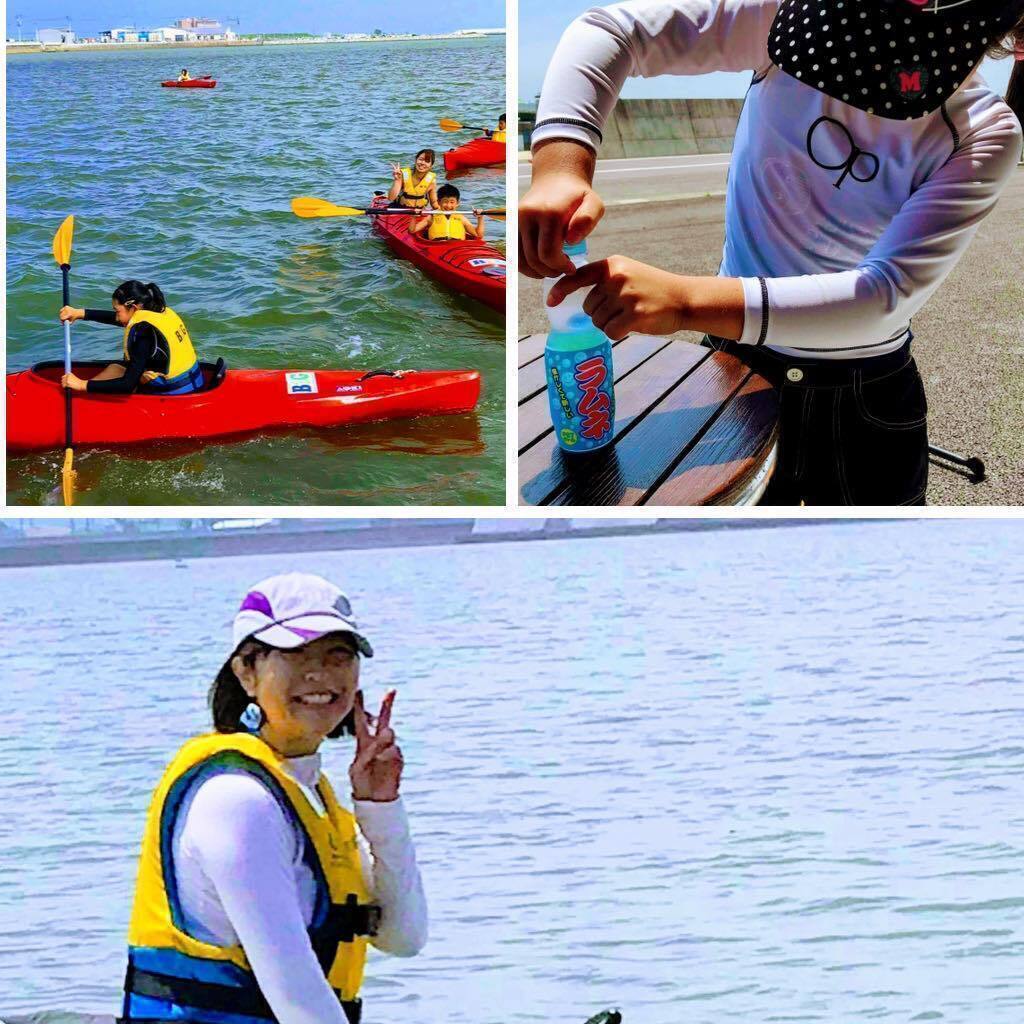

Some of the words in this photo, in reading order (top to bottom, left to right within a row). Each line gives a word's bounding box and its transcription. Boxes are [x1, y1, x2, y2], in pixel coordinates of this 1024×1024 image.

[898, 71, 922, 92] M
[574, 356, 611, 440] ラムネ
